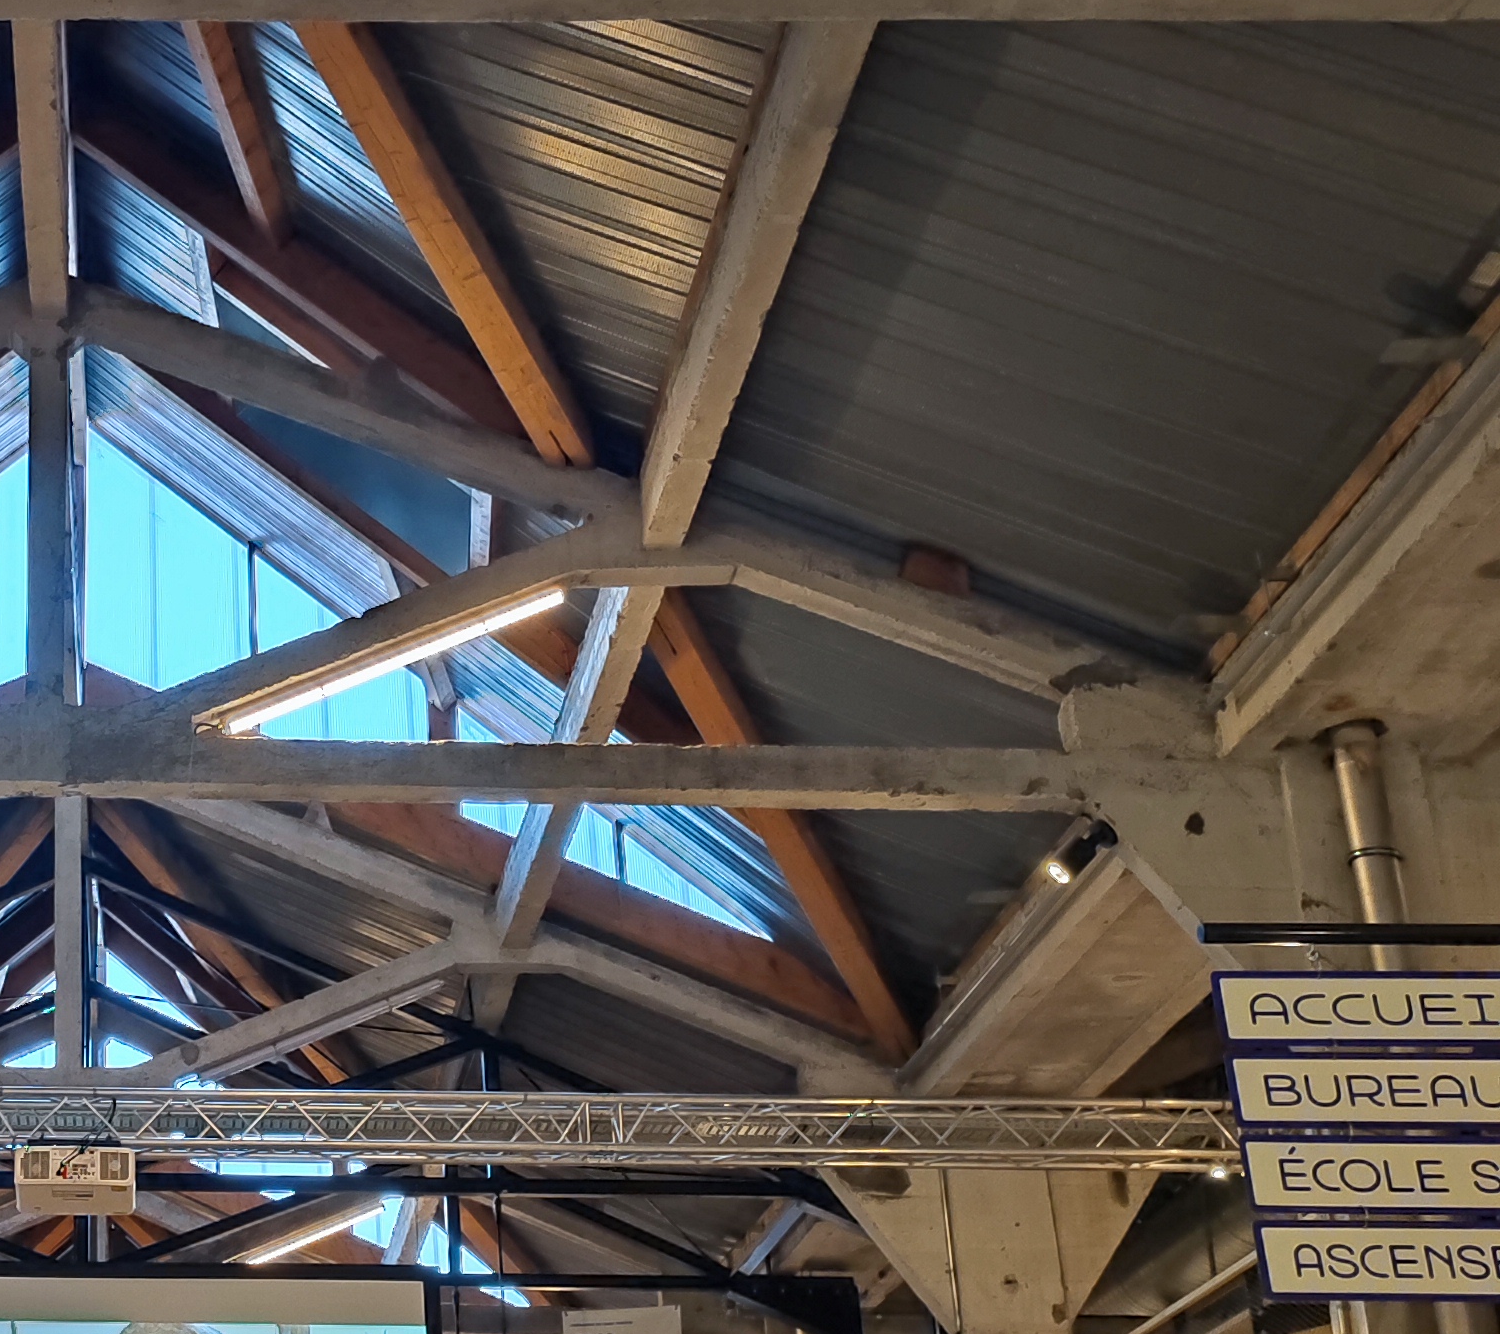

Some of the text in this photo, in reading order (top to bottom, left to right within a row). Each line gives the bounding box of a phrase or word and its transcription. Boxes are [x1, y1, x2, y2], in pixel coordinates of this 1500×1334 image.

[1249, 992, 1500, 1026] ACCUEI
[1262, 1074, 1500, 1107] BUREAU
[1278, 1146, 1450, 1194] ÉCOLE
